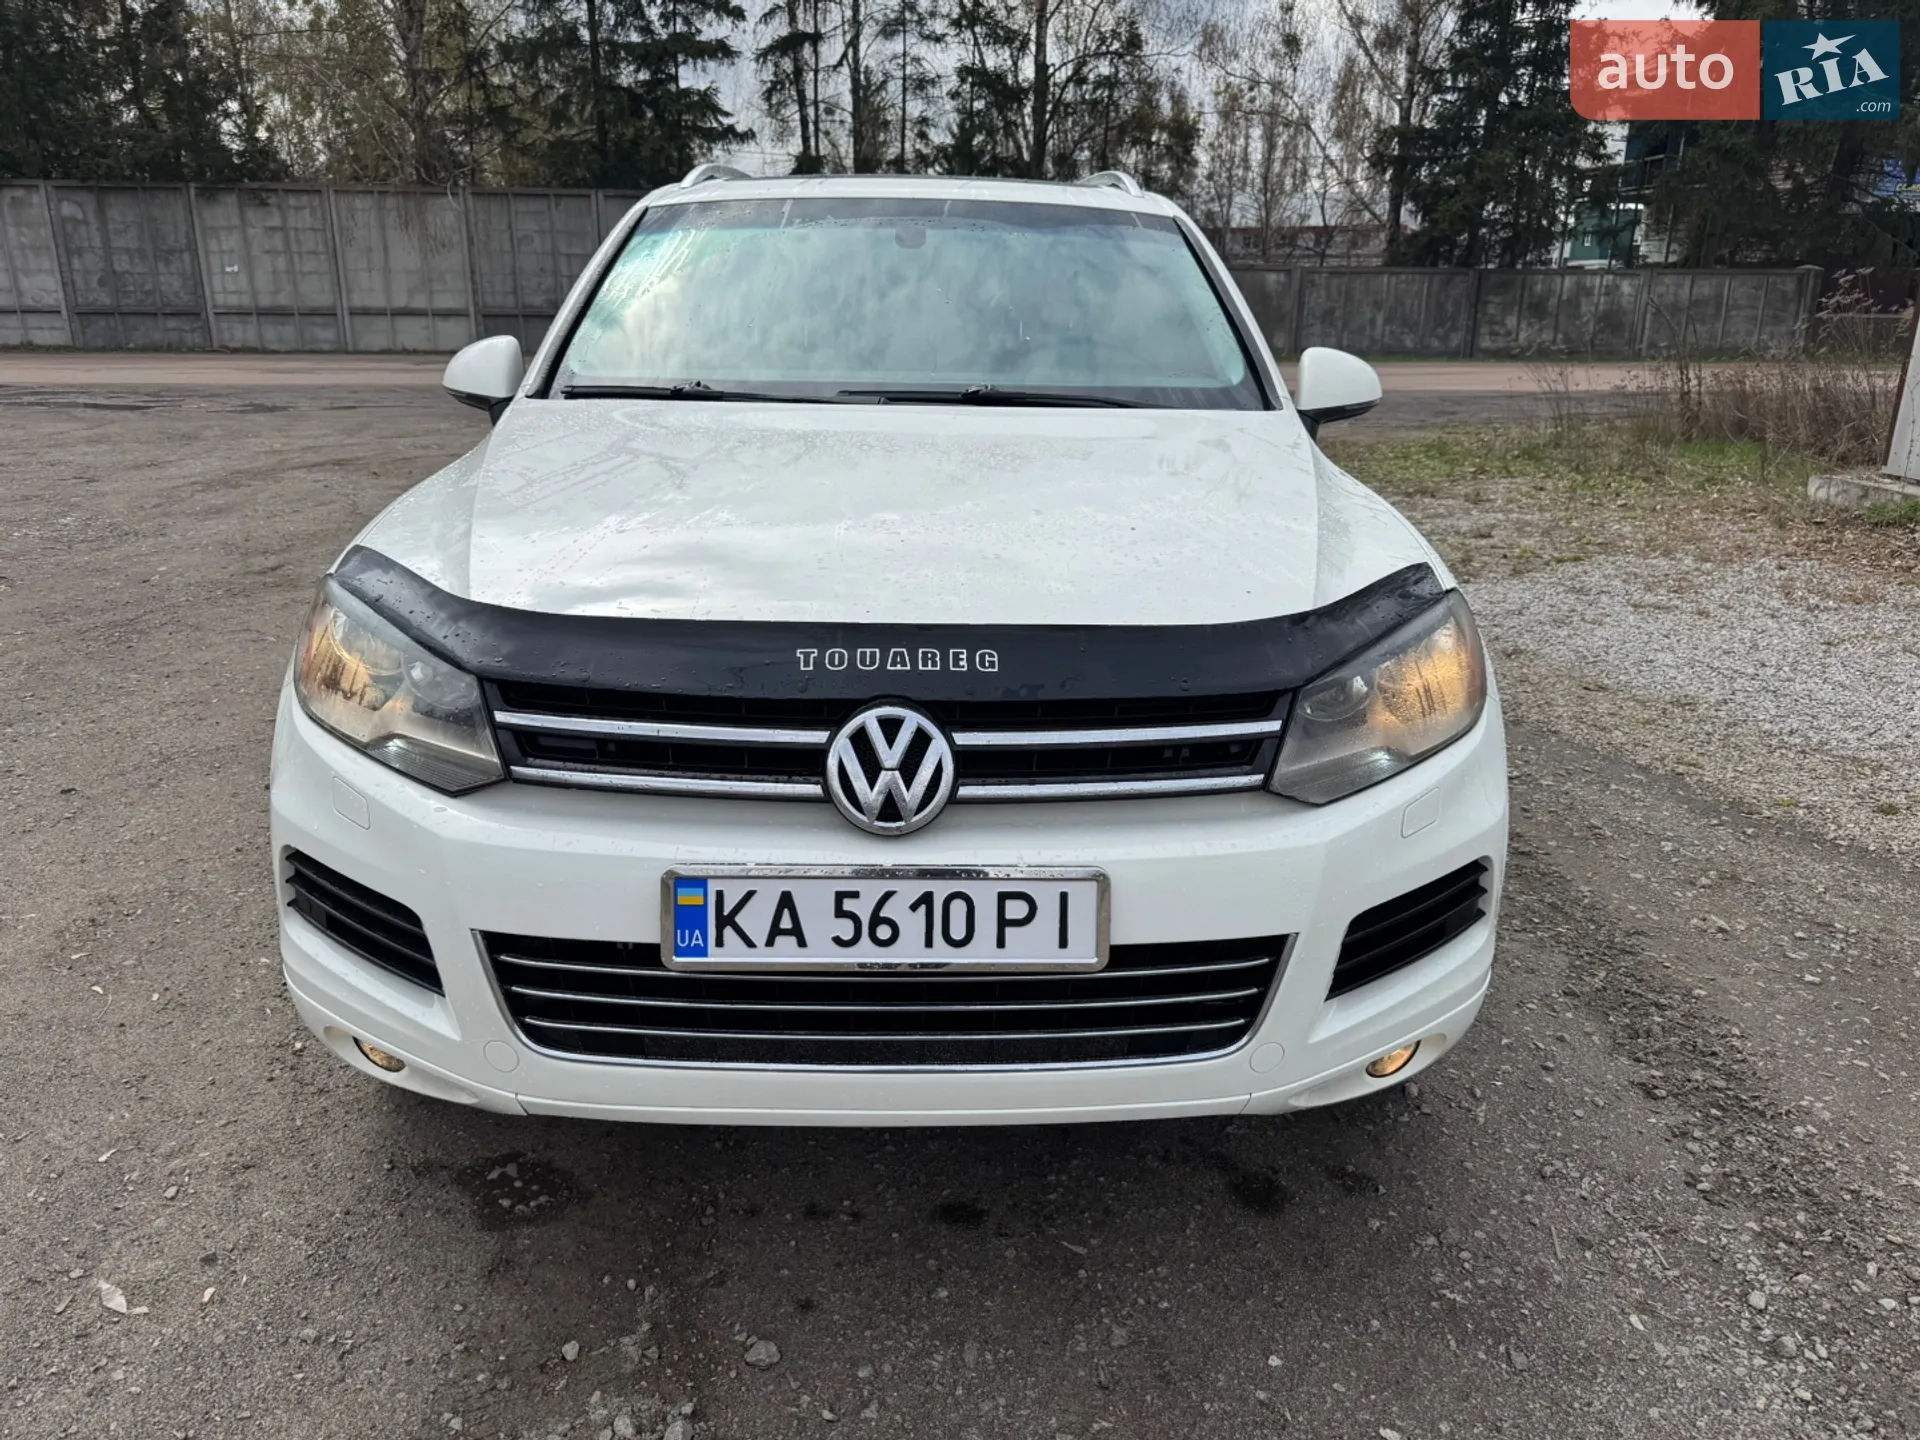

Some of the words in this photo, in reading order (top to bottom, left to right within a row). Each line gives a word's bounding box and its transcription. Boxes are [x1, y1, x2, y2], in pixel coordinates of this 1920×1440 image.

[796, 647, 999, 672] TOUAREG
[831, 709, 952, 833] VW
[676, 929, 704, 948] UA
[714, 889, 809, 949] KA
[830, 889, 976, 950] 5610
[995, 890, 1069, 950] PI
